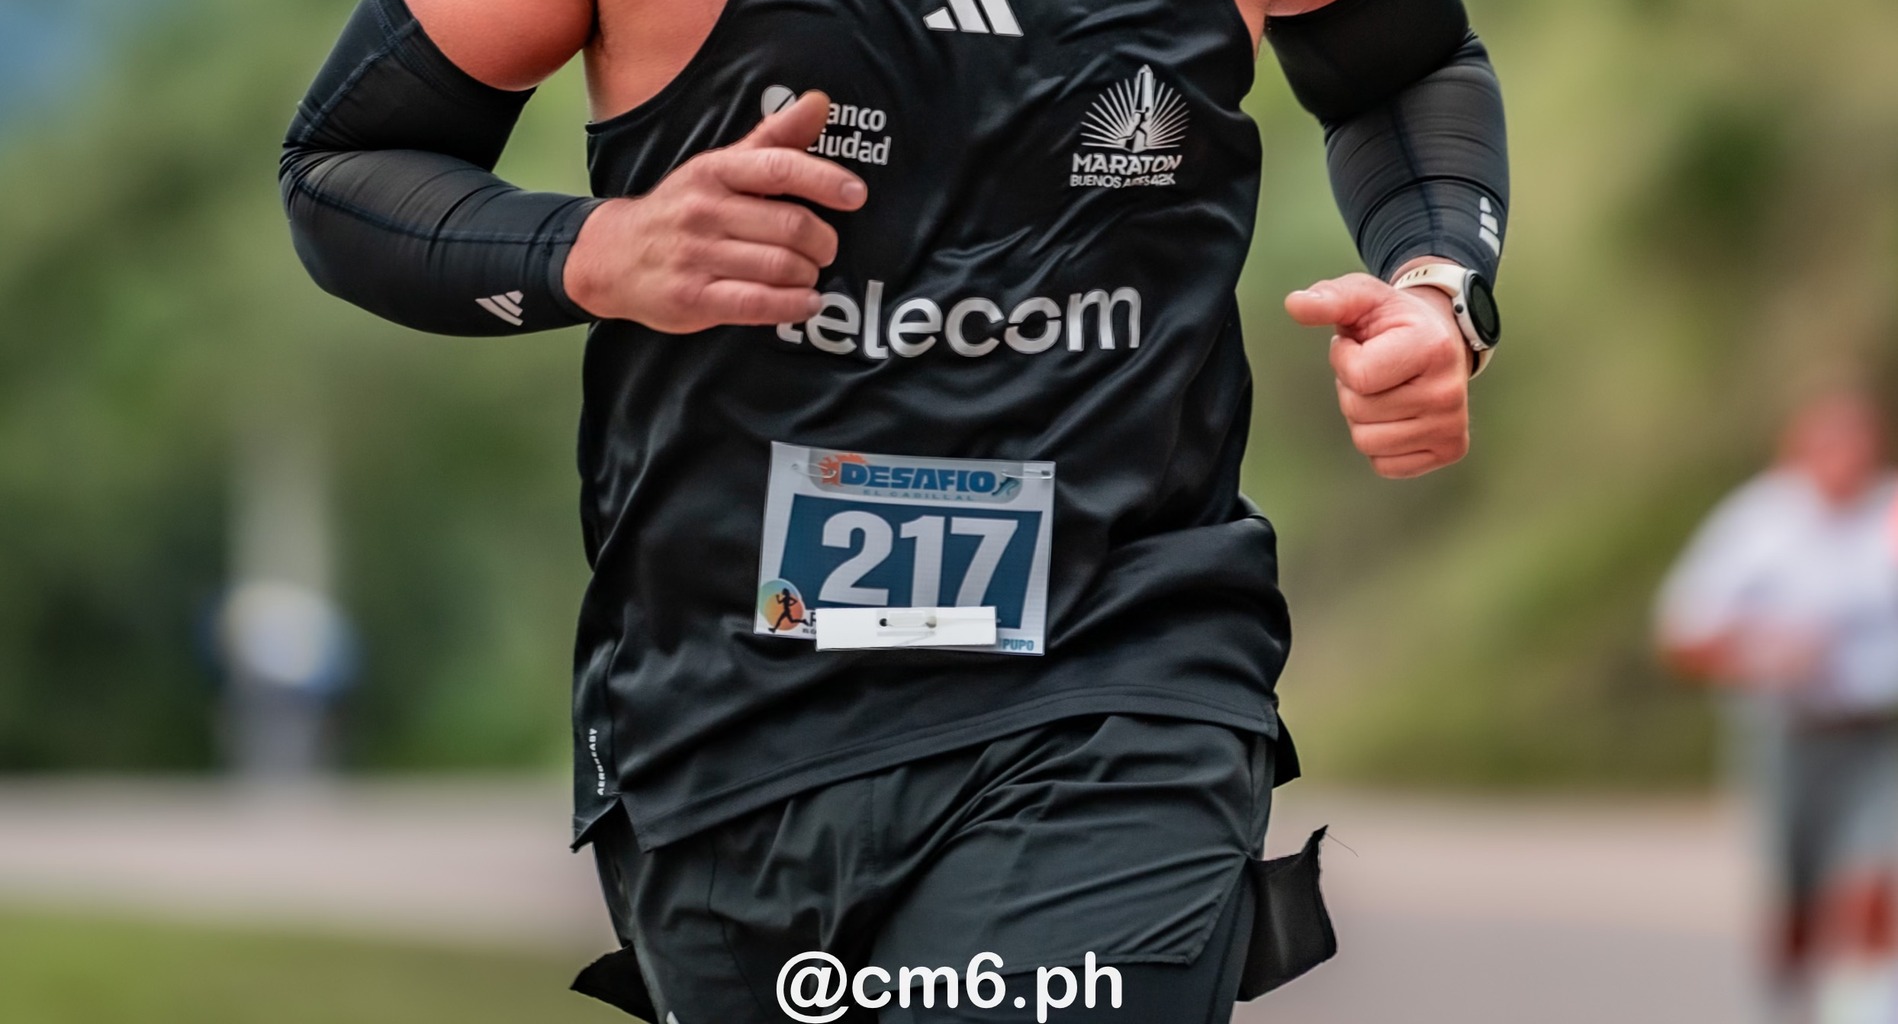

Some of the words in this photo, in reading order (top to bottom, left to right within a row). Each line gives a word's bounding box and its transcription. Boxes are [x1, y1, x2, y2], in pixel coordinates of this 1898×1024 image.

[826, 103, 887, 132] anco
[807, 128, 892, 166] iudad
[1071, 152, 1183, 176] MARATON
[1069, 174, 1122, 188] BUENOS
[841, 462, 996, 493] DESAFIO
[818, 510, 1018, 609] 217
